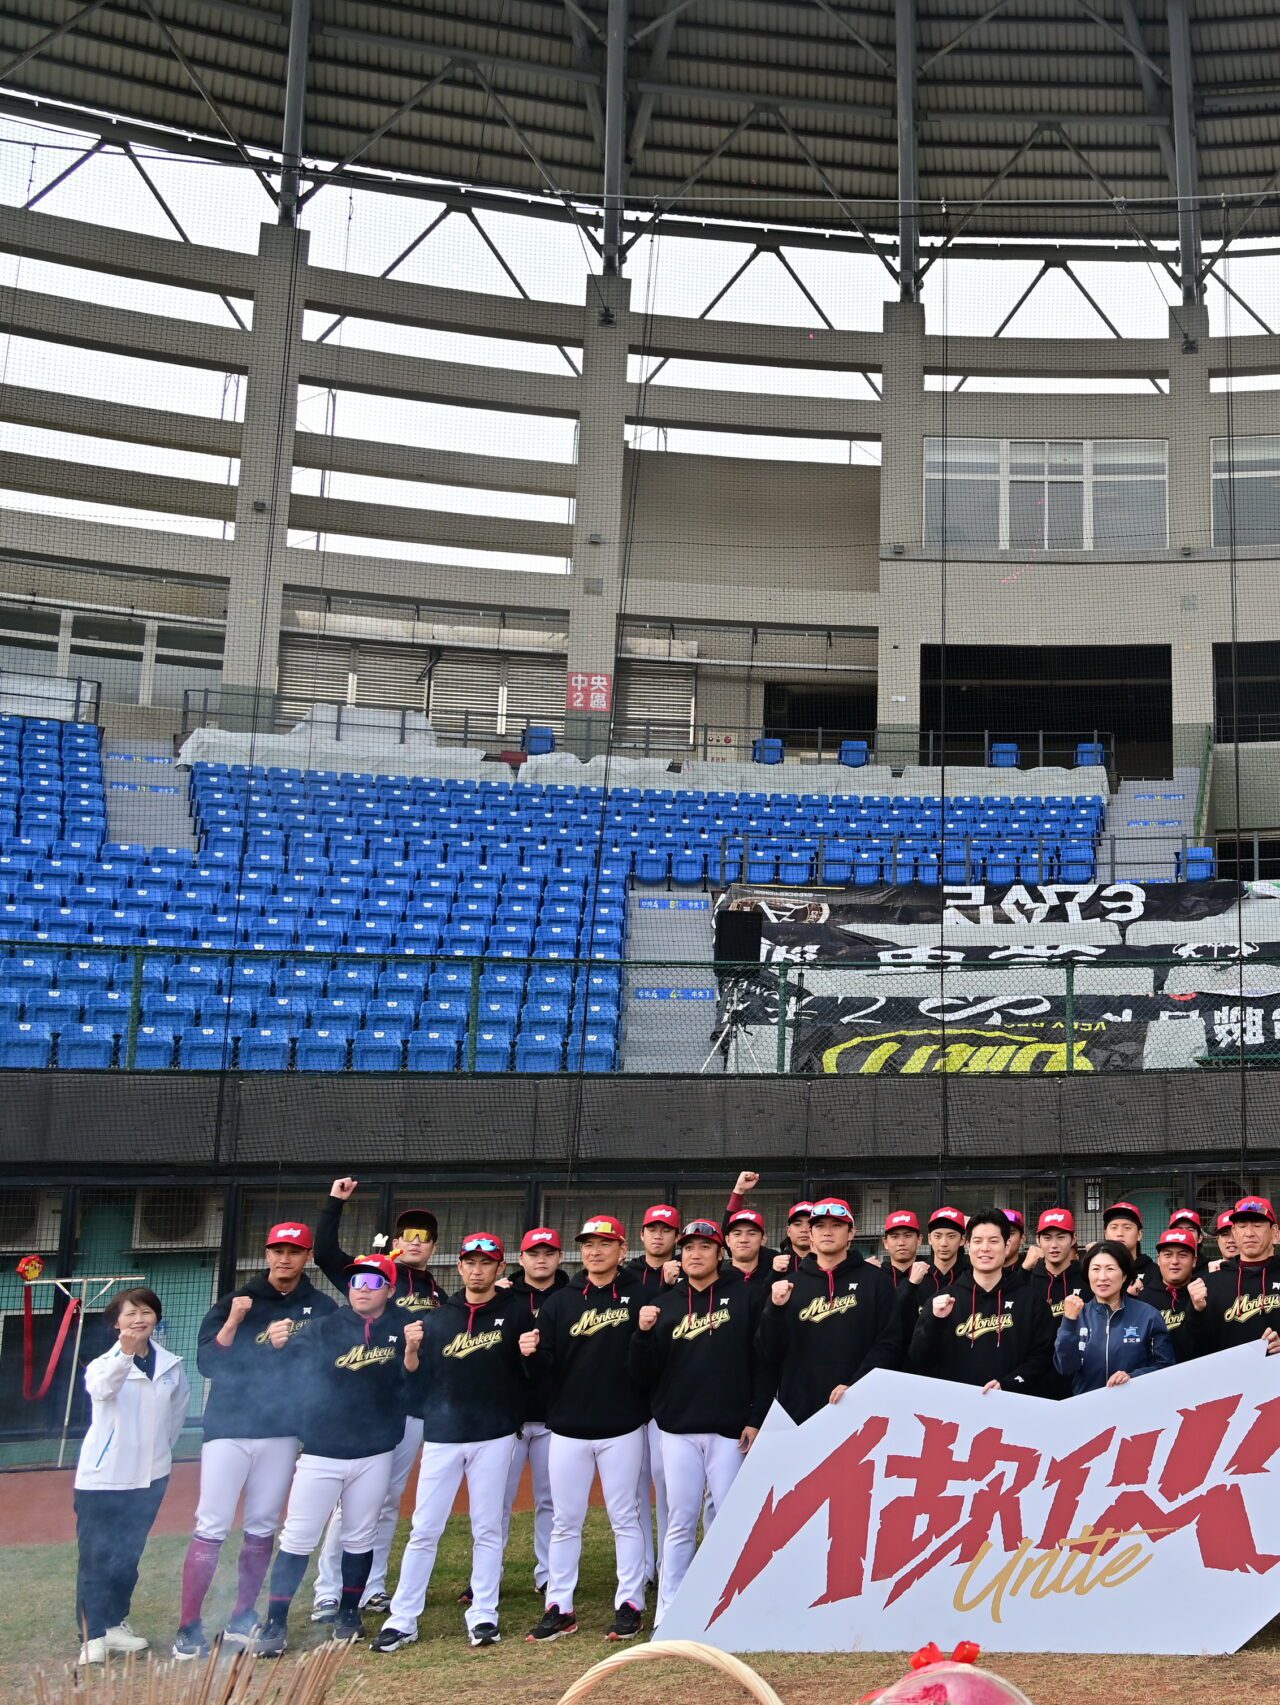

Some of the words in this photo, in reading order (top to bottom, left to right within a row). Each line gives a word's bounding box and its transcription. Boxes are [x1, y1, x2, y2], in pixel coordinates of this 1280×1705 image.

[571, 673, 608, 692] 中央
[572, 692, 607, 709] 2區
[570, 1307, 630, 1337] Monkeys
[799, 1293, 857, 1323] Monkeys
[672, 1308, 731, 1340] Monkeys
[955, 1312, 1014, 1340] Monkeys
[335, 1344, 397, 1372] Monkeys
[441, 1329, 503, 1360] Monkeys
[953, 1525, 1182, 1623] Unite
